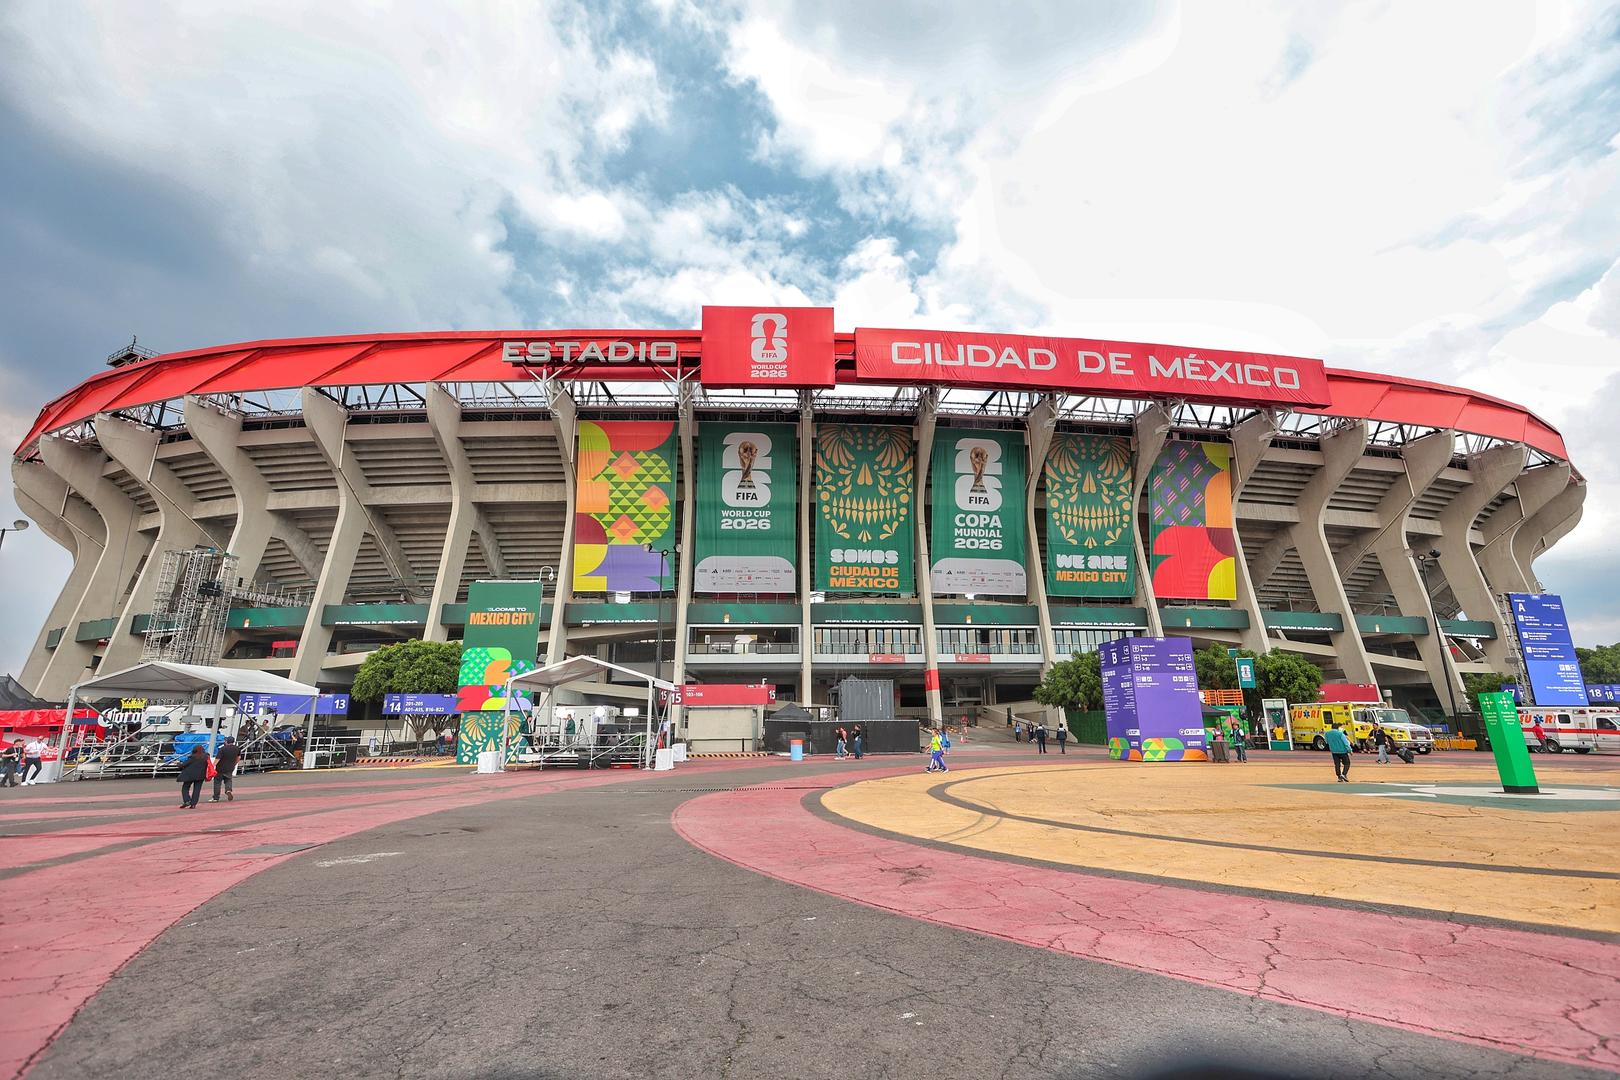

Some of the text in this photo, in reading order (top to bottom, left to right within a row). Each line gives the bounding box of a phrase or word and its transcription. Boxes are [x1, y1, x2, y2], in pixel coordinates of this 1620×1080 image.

[502, 341, 678, 363] ESTADIO
[891, 342, 1300, 389] CIUDAD DE MÉXICO
[750, 370, 787, 378] 2026
[736, 492, 758, 501] FIFA
[968, 496, 990, 505] FIFA
[721, 510, 771, 518] WORLD CUP
[721, 518, 771, 530] 2026
[955, 513, 1003, 528] COPA
[955, 528, 1003, 538] MUNDIAL
[955, 538, 1003, 550] 2026
[830, 548, 899, 564] SOMOS
[1056, 554, 1127, 570] WE ARE
[830, 565, 899, 577] CIUDAD DE
[1056, 570, 1127, 583] MEXICO CITY
[1518, 603, 1526, 612] A
[469, 612, 535, 625] MEXICO CITY
[1111, 652, 1118, 665] B
[661, 691, 667, 701] 15
[671, 692, 682, 703] 15
[768, 690, 776, 700] 15
[1589, 689, 1602, 698] 18
[1605, 690, 1614, 701] 18
[242, 701, 255, 712] 13
[334, 699, 346, 709] 13
[390, 702, 401, 713] 14
